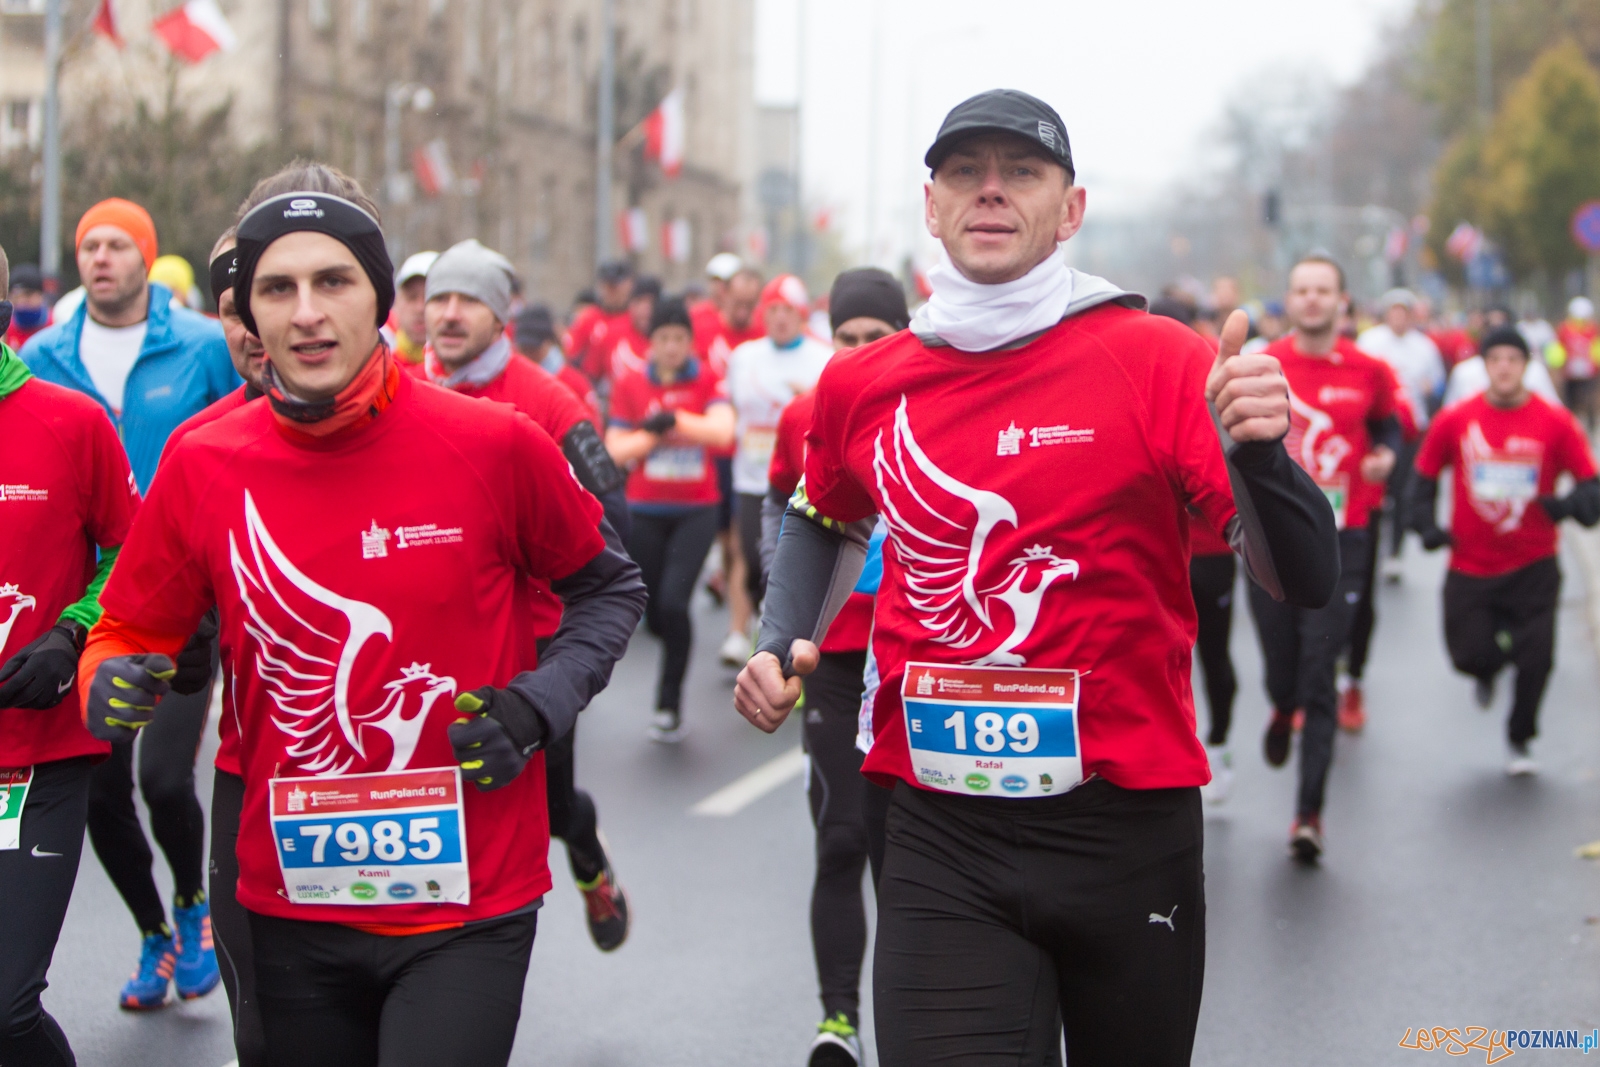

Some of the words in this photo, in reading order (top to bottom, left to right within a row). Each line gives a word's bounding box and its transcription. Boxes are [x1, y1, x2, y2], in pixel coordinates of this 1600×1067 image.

[394, 526, 409, 548] 1
[993, 683, 1065, 696] RunPoland.org
[911, 718, 923, 733] E
[944, 710, 1040, 753] 189
[975, 760, 1003, 770] Rafał
[370, 786, 446, 800] RunPoland.org
[282, 838, 296, 852] E
[299, 817, 443, 863] 7985
[358, 869, 391, 878] Kamil
